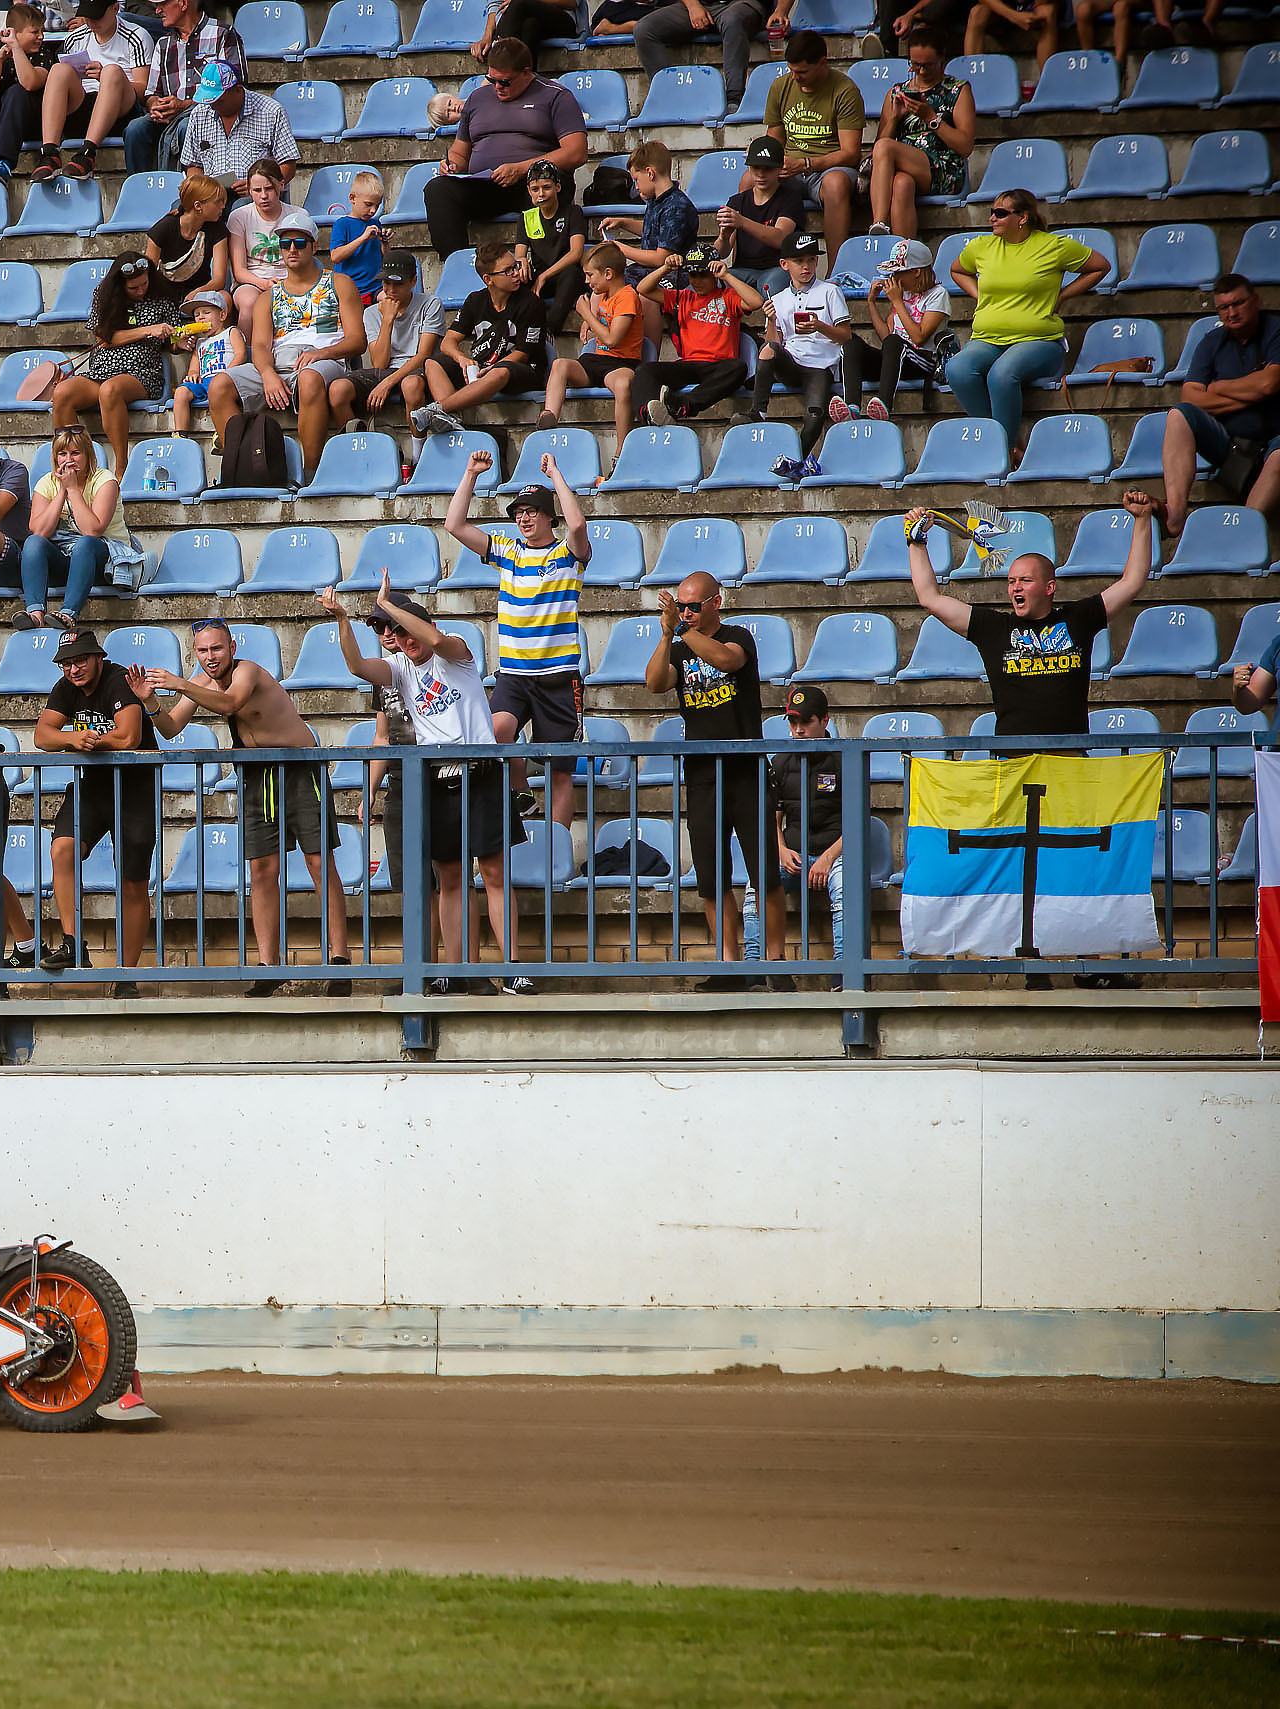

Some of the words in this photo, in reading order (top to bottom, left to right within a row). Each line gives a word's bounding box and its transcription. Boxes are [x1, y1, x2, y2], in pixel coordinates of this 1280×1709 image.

[359, 5, 372, 16] 38
[451, 1, 463, 11] 37
[264, 7, 280, 18] 39
[1069, 57, 1087, 70] 30
[1171, 52, 1189, 64] 29
[873, 67, 888, 78] 32
[971, 61, 984, 73] 31
[577, 77, 591, 89] 35
[678, 72, 692, 84] 34
[298, 88, 314, 98] 38
[394, 83, 409, 95] 37
[1118, 142, 1137, 153] 29
[1221, 136, 1239, 148] 28
[1016, 146, 1032, 158] 30
[723, 158, 736, 169] 33
[148, 177, 164, 188] 39
[337, 172, 351, 183] 37
[56, 184, 70, 194] 40
[1168, 231, 1184, 243] 28
[865, 239, 877, 251] 31
[91, 268, 106, 279] 39
[690, 308, 731, 327] adidas
[1113, 324, 1136, 337] 28
[23, 356, 40, 368] 39
[851, 426, 871, 438] 30
[1065, 420, 1080, 432] 28
[551, 434, 567, 446] 33
[650, 432, 670, 444] 32
[752, 430, 764, 441] 31
[962, 428, 981, 441] 29
[352, 438, 366, 450] 35
[449, 436, 463, 447] 34
[158, 445, 172, 457] 37
[1111, 516, 1130, 528] 27
[1224, 513, 1239, 525] 26
[594, 526, 610, 539] 32
[695, 526, 708, 538] 31
[796, 525, 813, 536] 30
[1009, 521, 1024, 533] 28
[194, 535, 209, 547] 36
[290, 534, 306, 546] 35
[389, 532, 404, 544] 34
[1169, 612, 1184, 625] 26
[637, 624, 649, 636] 31
[853, 620, 871, 632] 29
[33, 636, 47, 648] 37
[132, 633, 146, 645] 36
[1006, 653, 1081, 675] APATOR
[889, 719, 908, 731] 28
[1108, 715, 1124, 728] 26
[1219, 714, 1236, 727] 25
[11, 835, 25, 847] 36
[212, 831, 226, 844] 34
